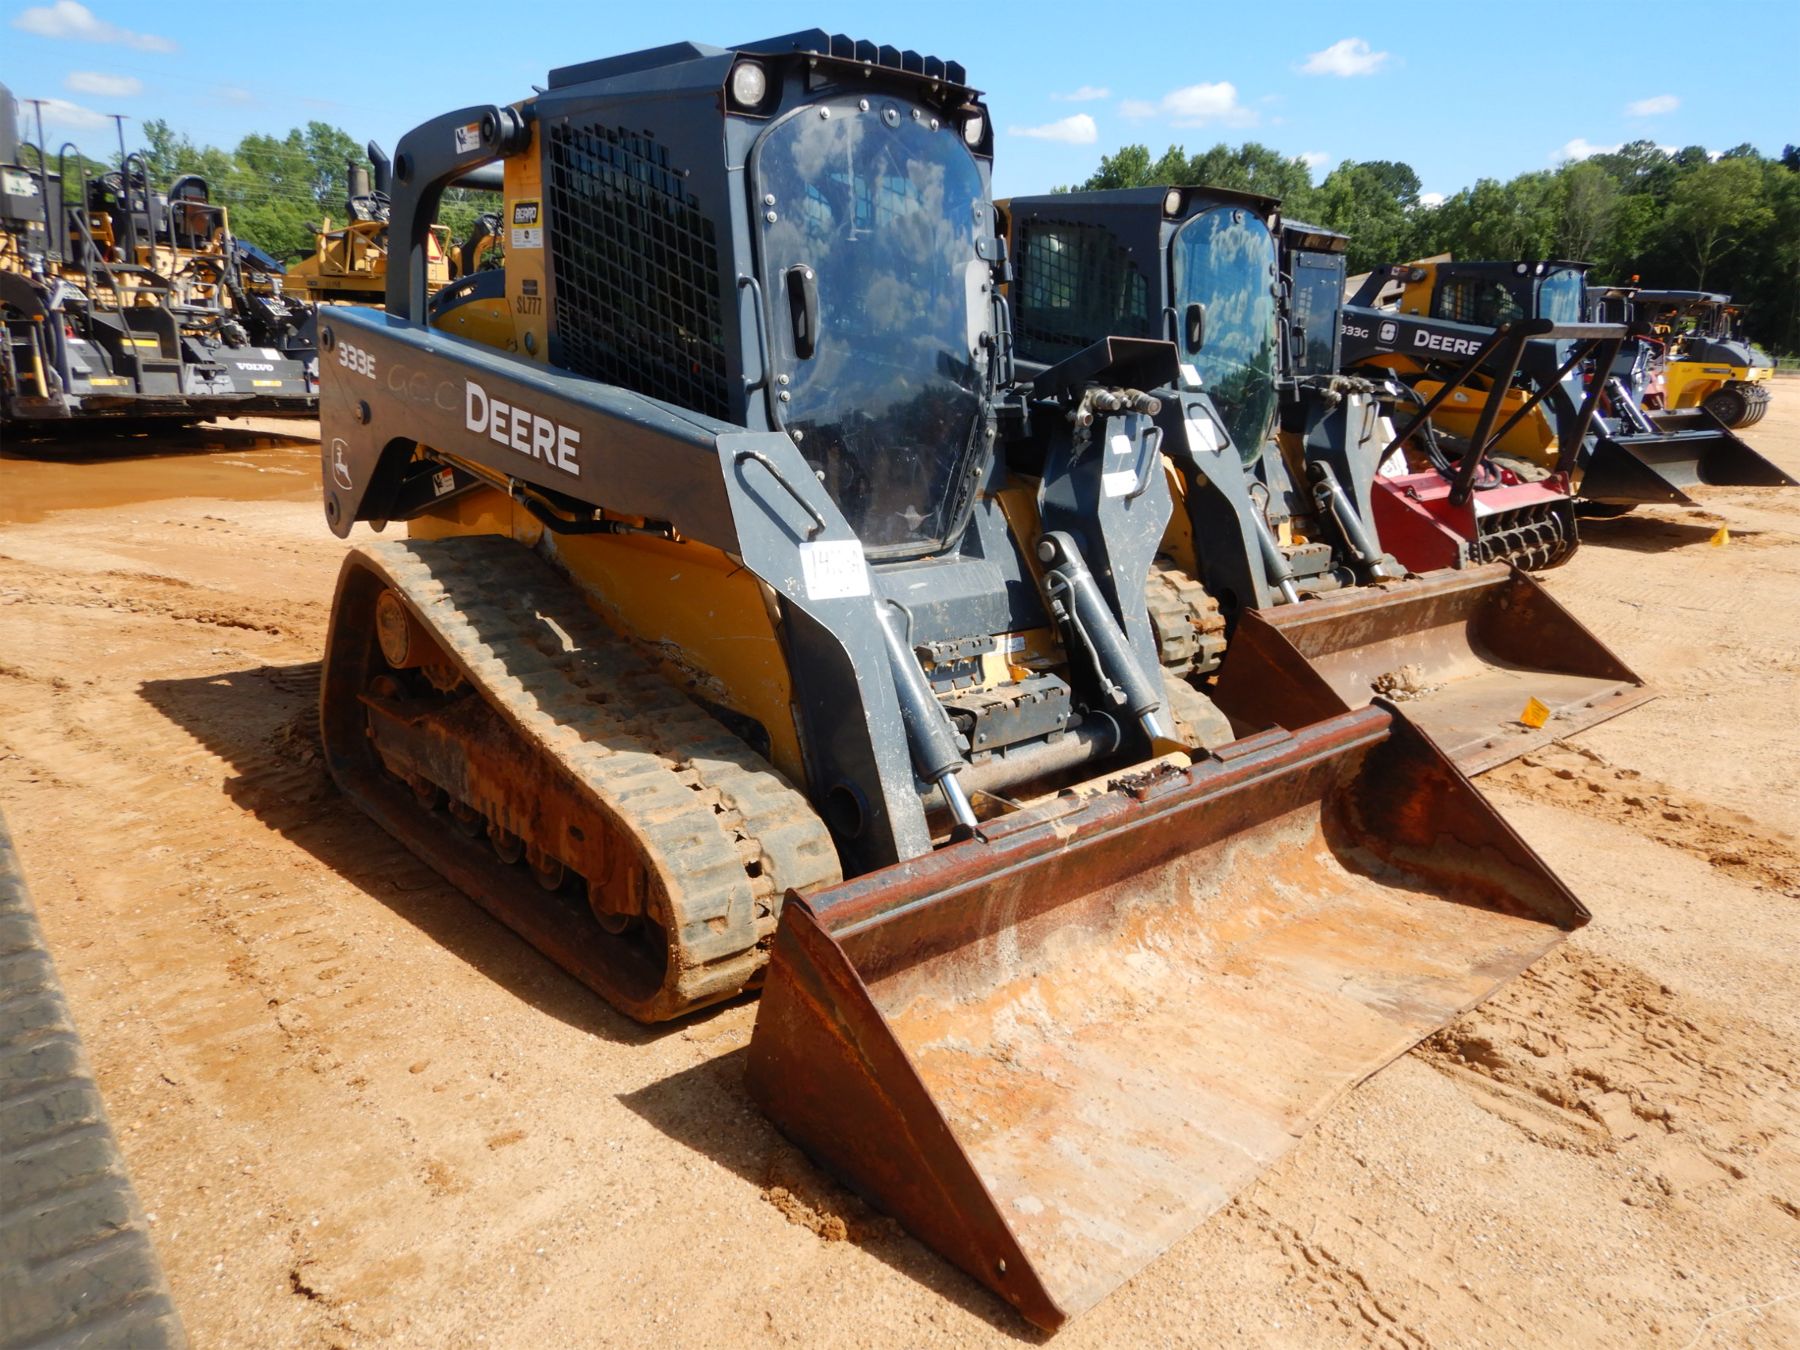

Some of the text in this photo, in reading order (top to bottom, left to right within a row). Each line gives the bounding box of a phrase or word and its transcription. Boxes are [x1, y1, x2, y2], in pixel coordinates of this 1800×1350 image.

[517, 297, 541, 314] SL777
[1414, 330, 1481, 355] DEERE
[235, 362, 274, 372] VOLVO
[337, 342, 376, 380] 333E
[465, 380, 580, 475] DEERE
